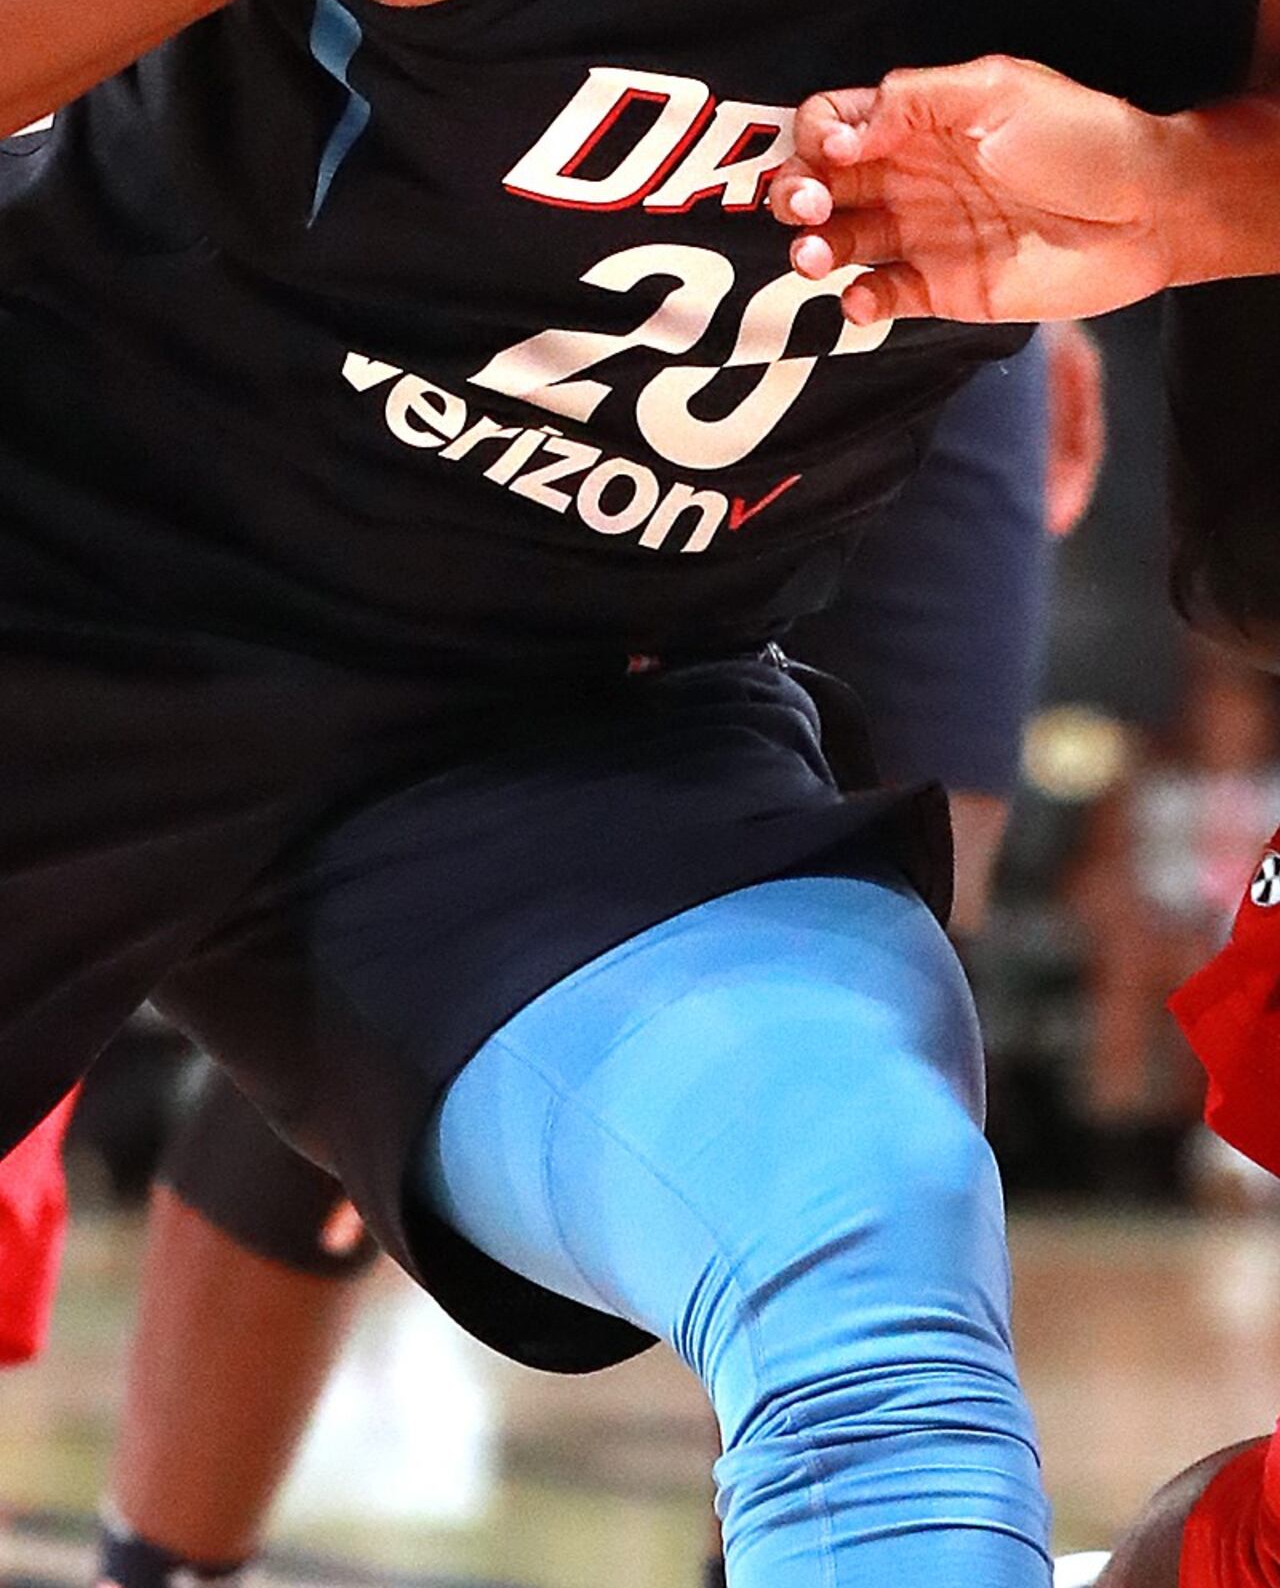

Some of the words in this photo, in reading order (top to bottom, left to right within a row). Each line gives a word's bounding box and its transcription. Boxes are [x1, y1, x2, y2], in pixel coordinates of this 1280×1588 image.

[501, 66, 800, 215] DR
[340, 351, 730, 554] verizon
[466, 243, 895, 470] 20
